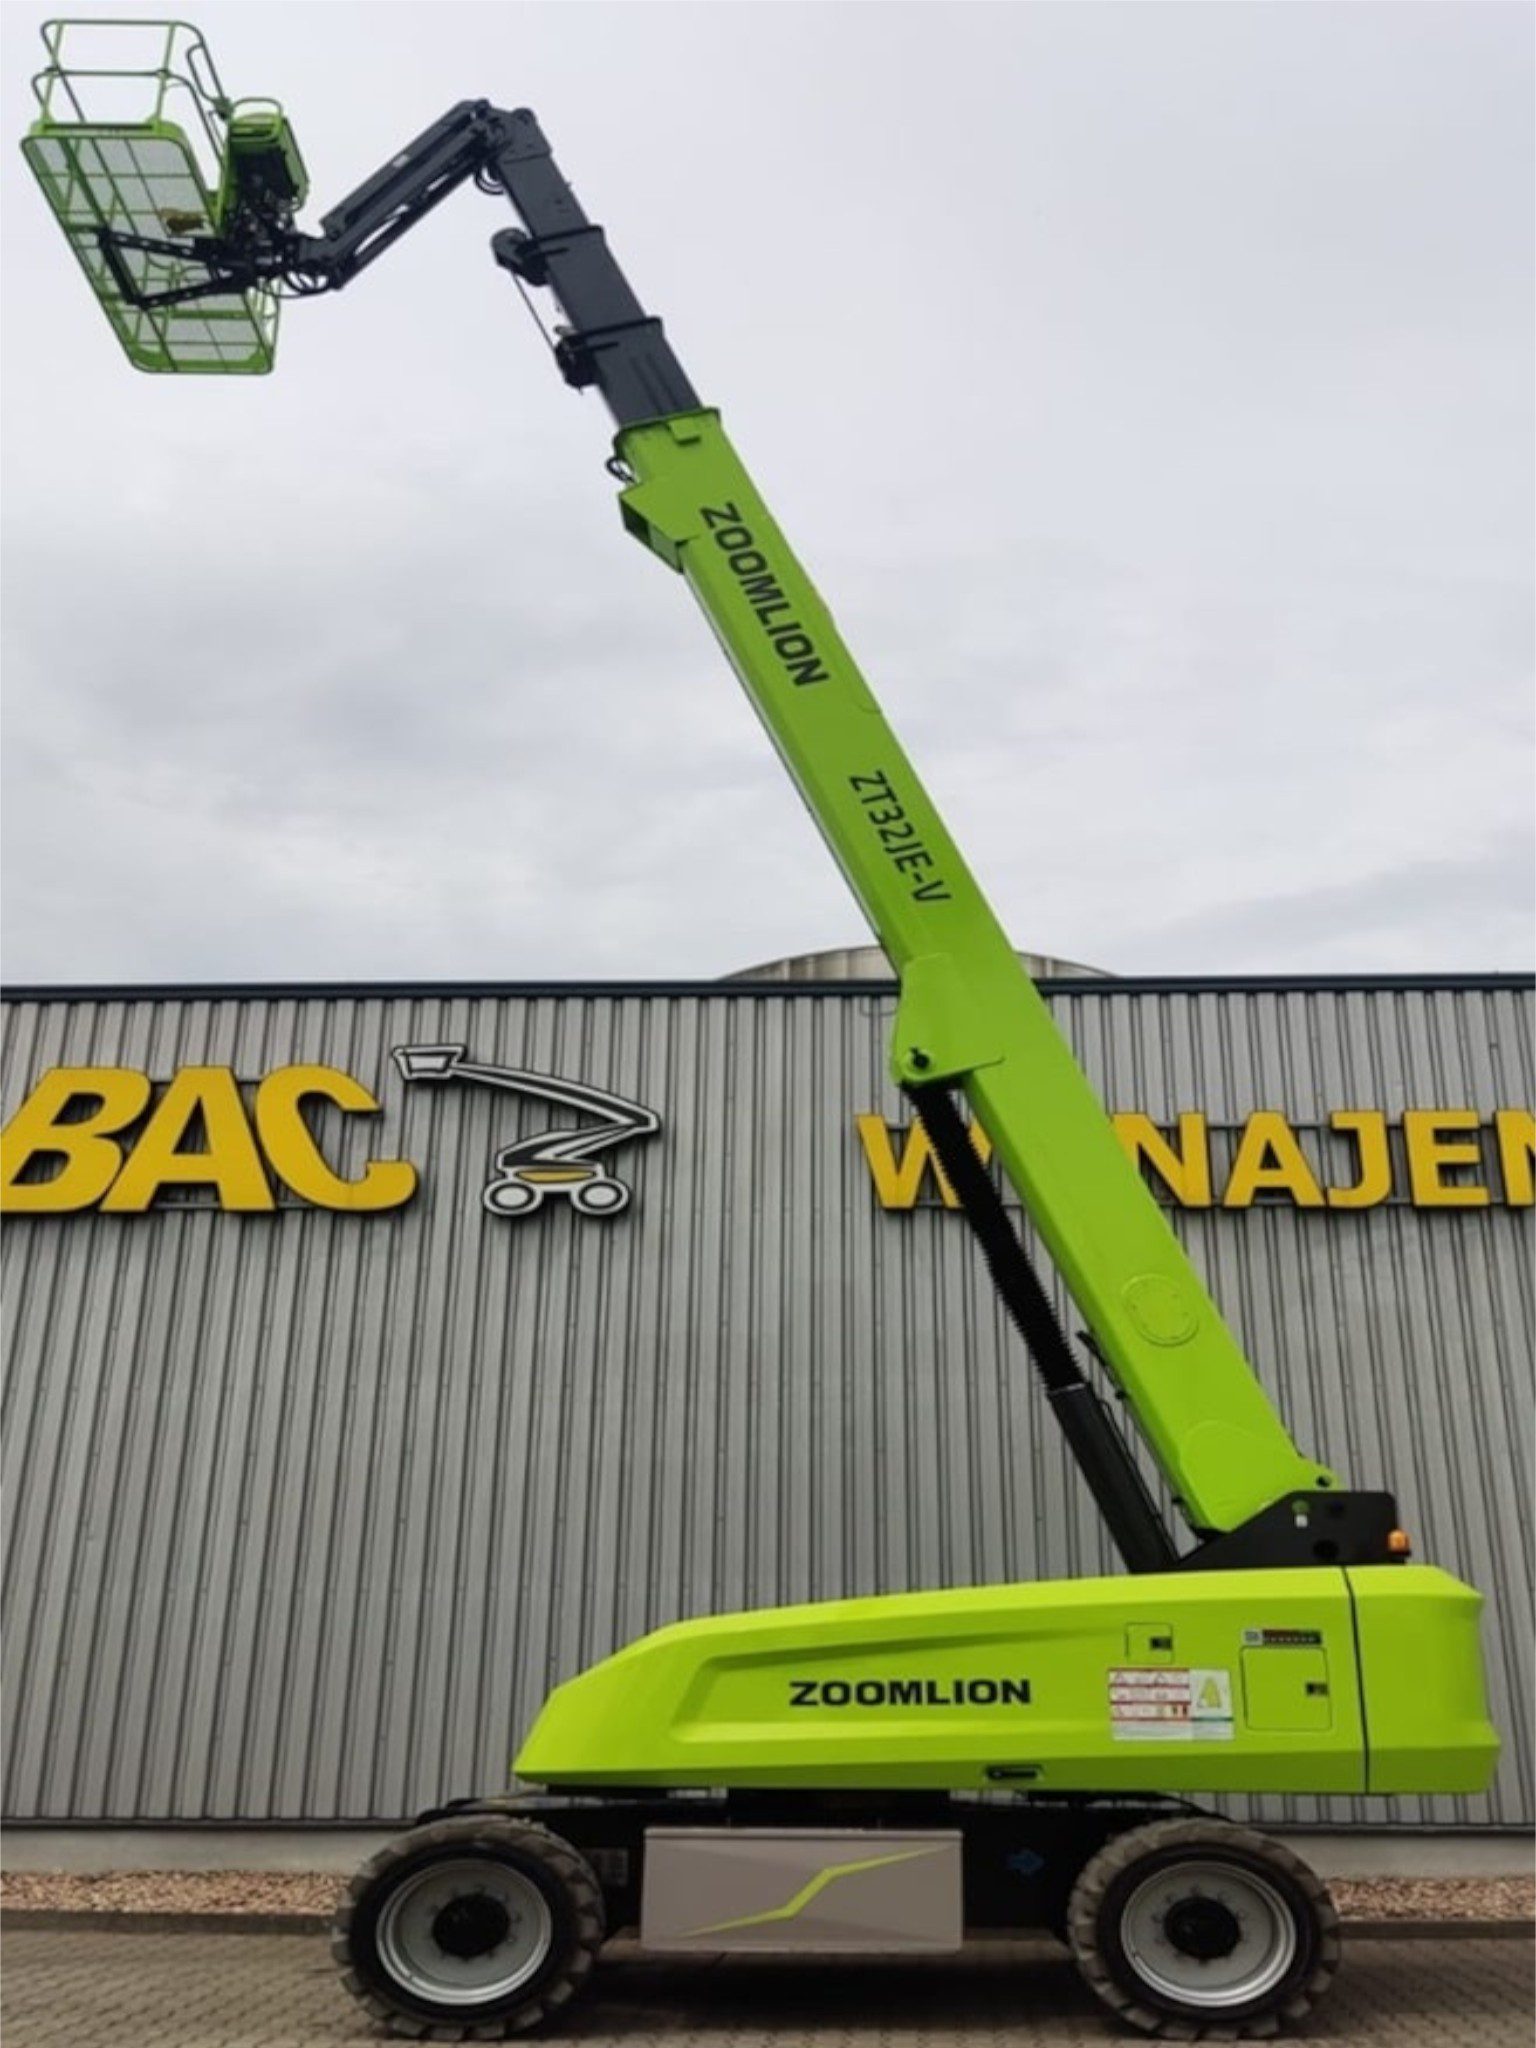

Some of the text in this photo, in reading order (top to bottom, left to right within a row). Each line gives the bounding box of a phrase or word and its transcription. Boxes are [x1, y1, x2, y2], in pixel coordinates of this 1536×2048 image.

[700, 501, 830, 687] ZOOMLION
[849, 769, 952, 903] ZT32JE-V
[0, 1065, 418, 1213] BAC
[856, 1110, 1536, 1208] WNAJE
[789, 1679, 1031, 1706] ZOOMLION
